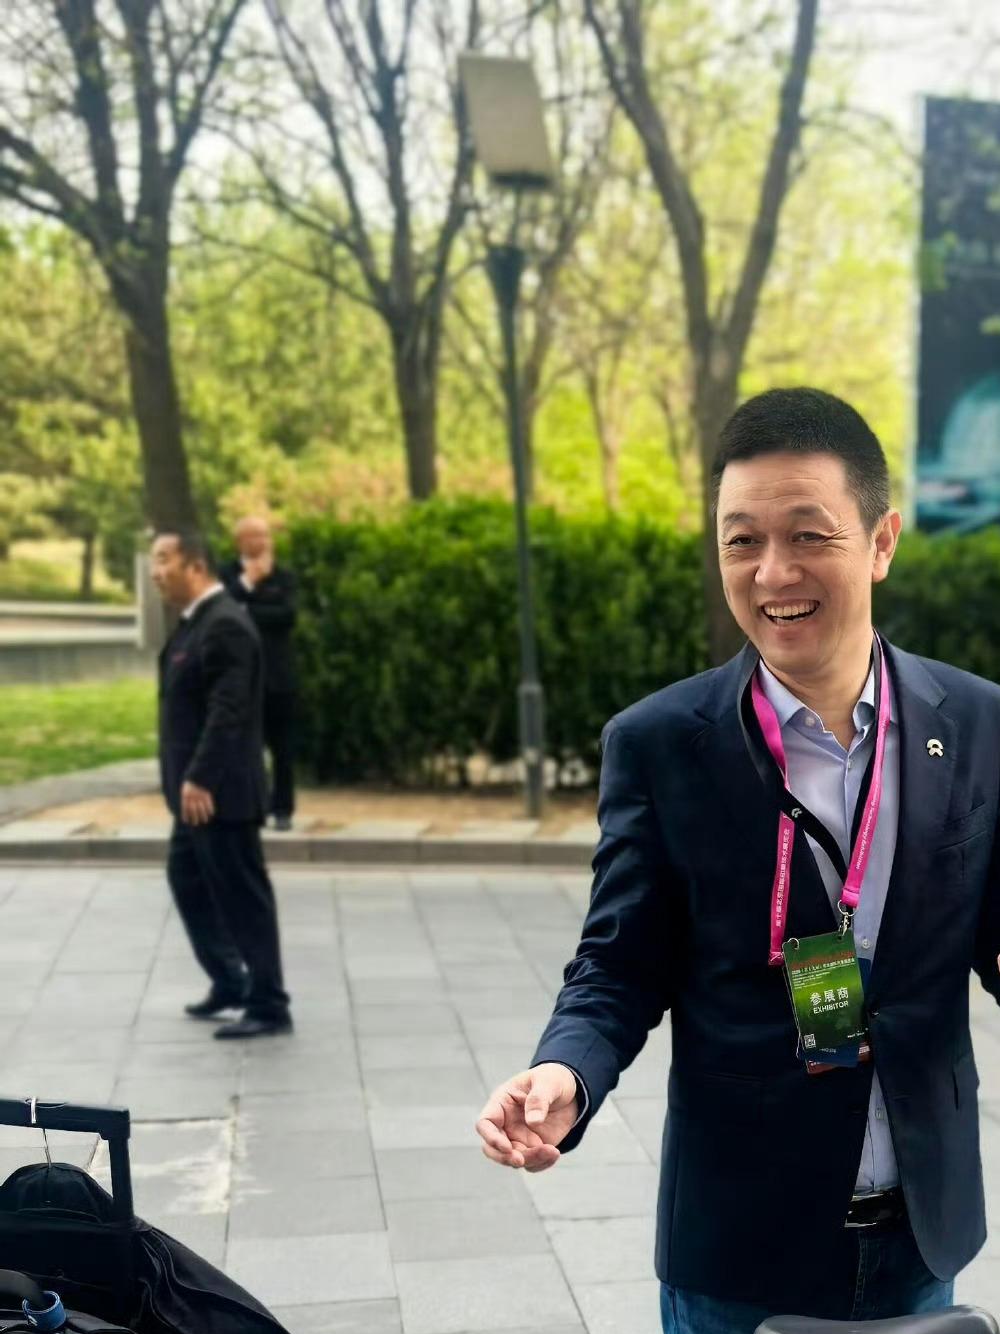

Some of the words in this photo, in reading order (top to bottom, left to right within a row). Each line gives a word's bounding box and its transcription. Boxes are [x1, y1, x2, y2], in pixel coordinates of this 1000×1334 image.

[810, 987, 849, 1006] 参展商
[813, 1000, 849, 1014] EXHIBITOR
